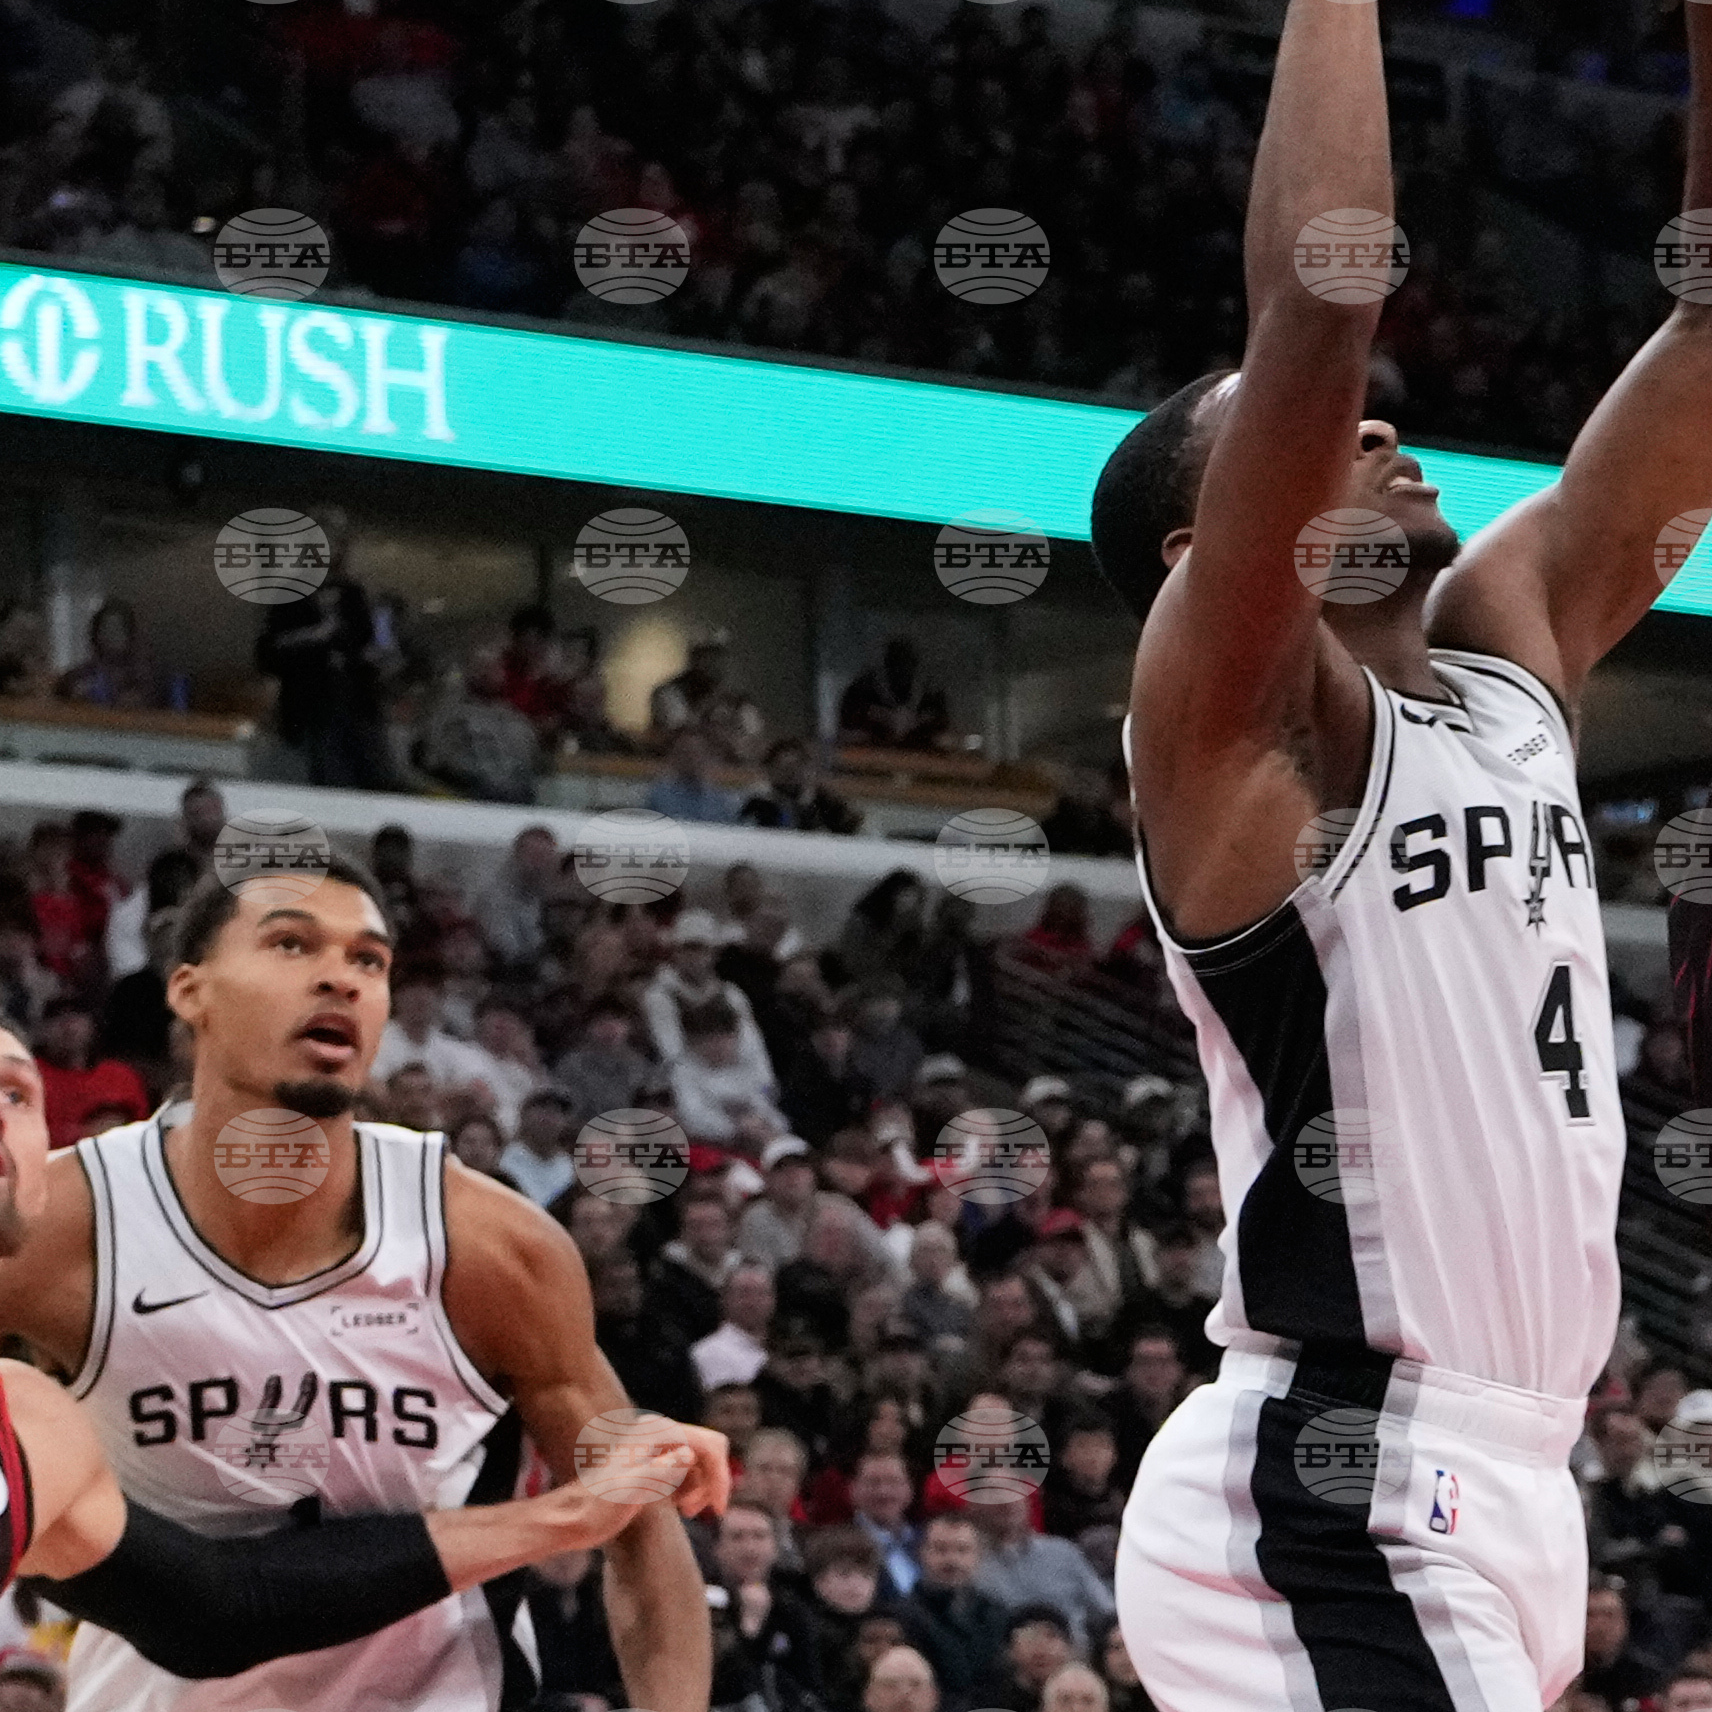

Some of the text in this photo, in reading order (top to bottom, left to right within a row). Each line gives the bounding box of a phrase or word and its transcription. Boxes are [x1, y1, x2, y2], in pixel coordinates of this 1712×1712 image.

[121, 289, 457, 443] RUSH
[1531, 961, 1595, 1126] 4
[128, 1370, 439, 1467] SPURS
